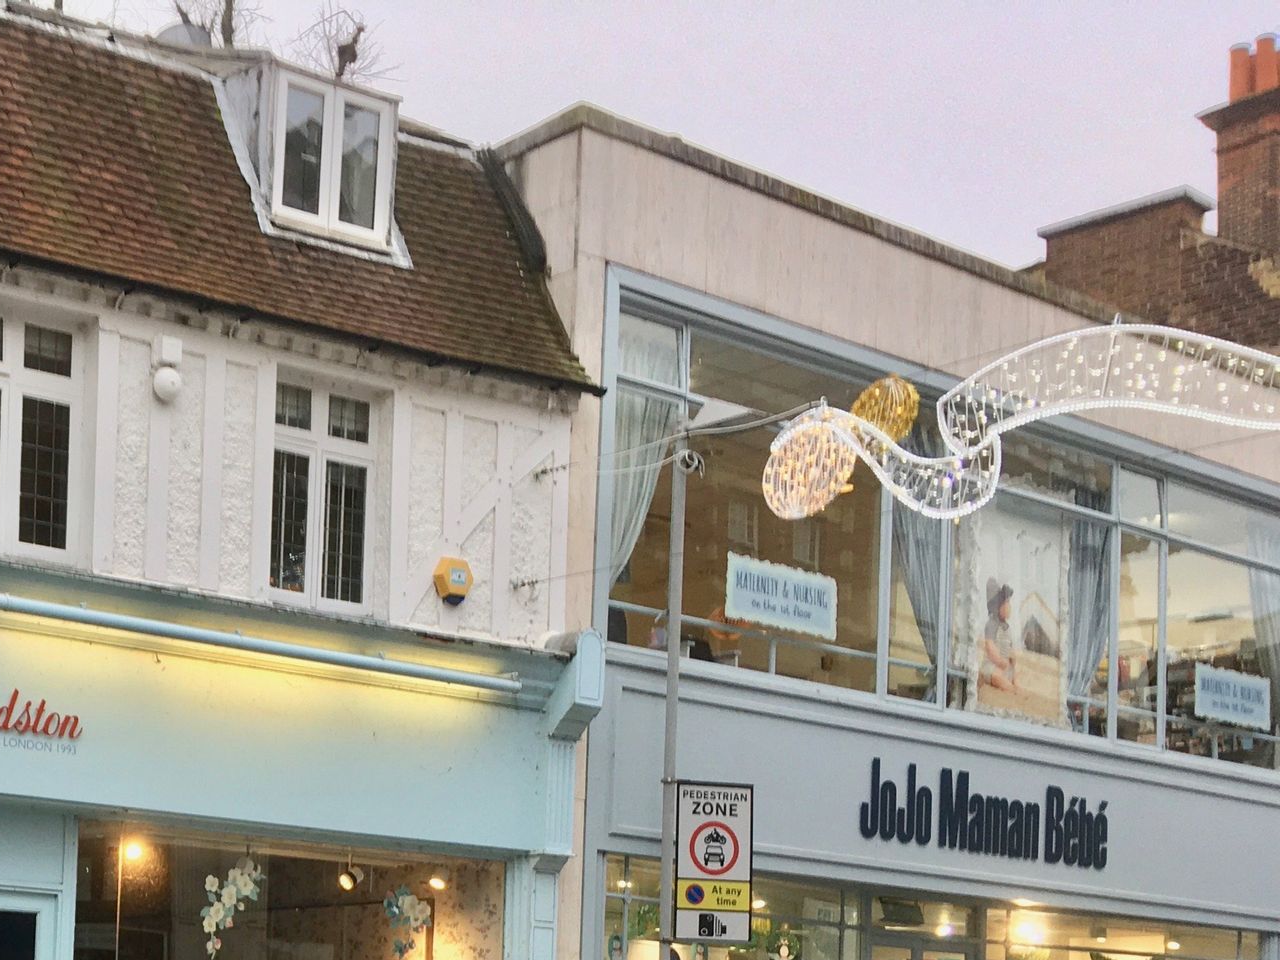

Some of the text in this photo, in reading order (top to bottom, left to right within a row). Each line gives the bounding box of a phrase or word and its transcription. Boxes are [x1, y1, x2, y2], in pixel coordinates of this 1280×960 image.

[736, 570, 828, 609] MATERNITY & NURSING
[751, 599, 761, 608] on
[763, 599, 777, 613] the
[793, 604, 812, 619] floor
[3, 737, 53, 753] LONDON
[682, 789, 748, 802] PEDESTRIAN
[691, 801, 739, 817] ZONE
[859, 756, 1109, 870] JoJo Maman Bébé
[711, 885, 742, 897] At any
[716, 897, 737, 906] time
